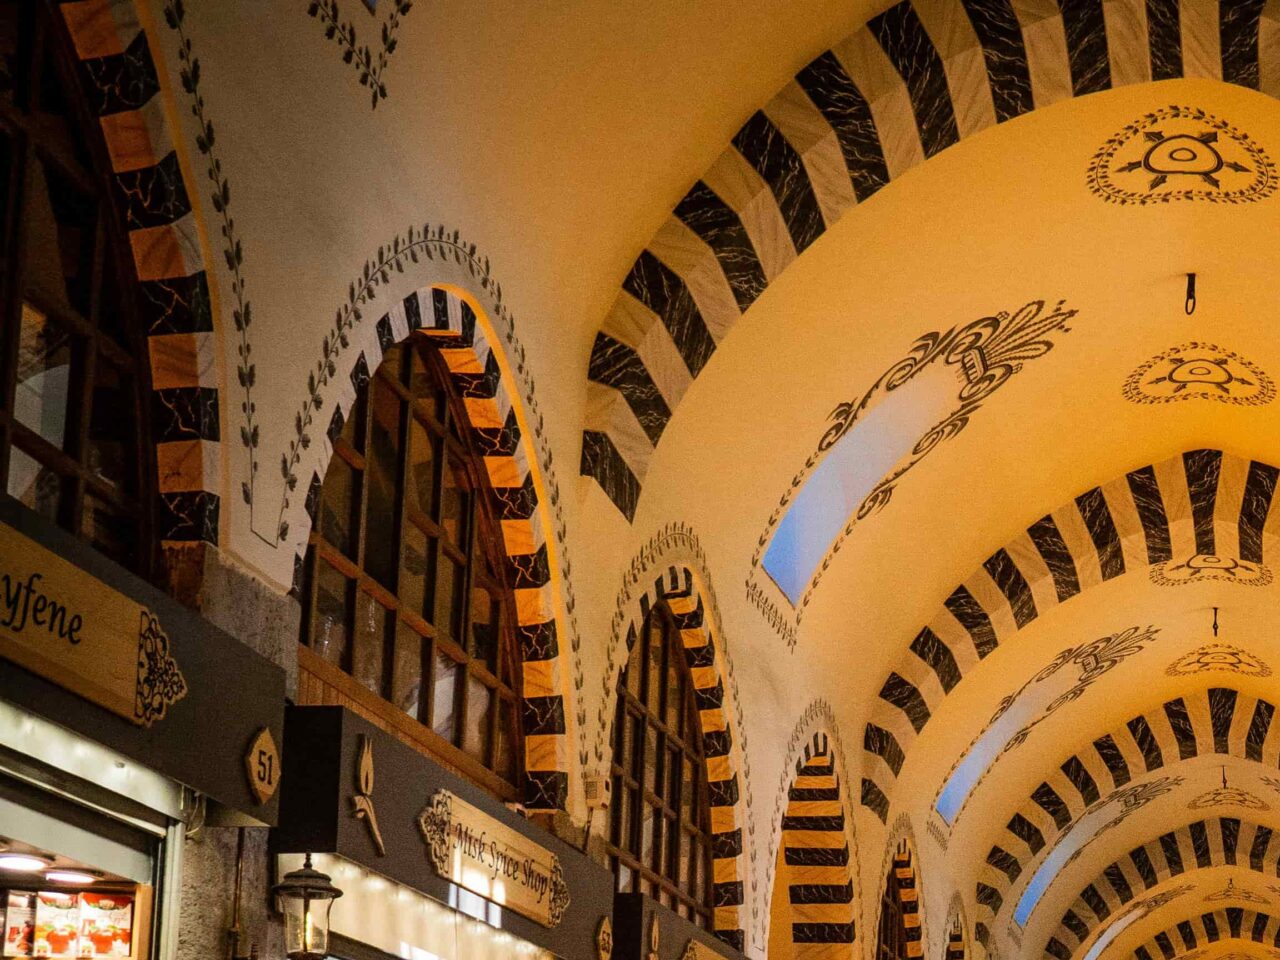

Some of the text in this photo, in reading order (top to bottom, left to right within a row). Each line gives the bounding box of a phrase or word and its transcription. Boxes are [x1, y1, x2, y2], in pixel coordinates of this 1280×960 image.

[0, 573, 82, 645] yfene
[258, 749, 272, 785] 51
[453, 822, 549, 904] Misk Spice Shop
[601, 929, 611, 954] 53
